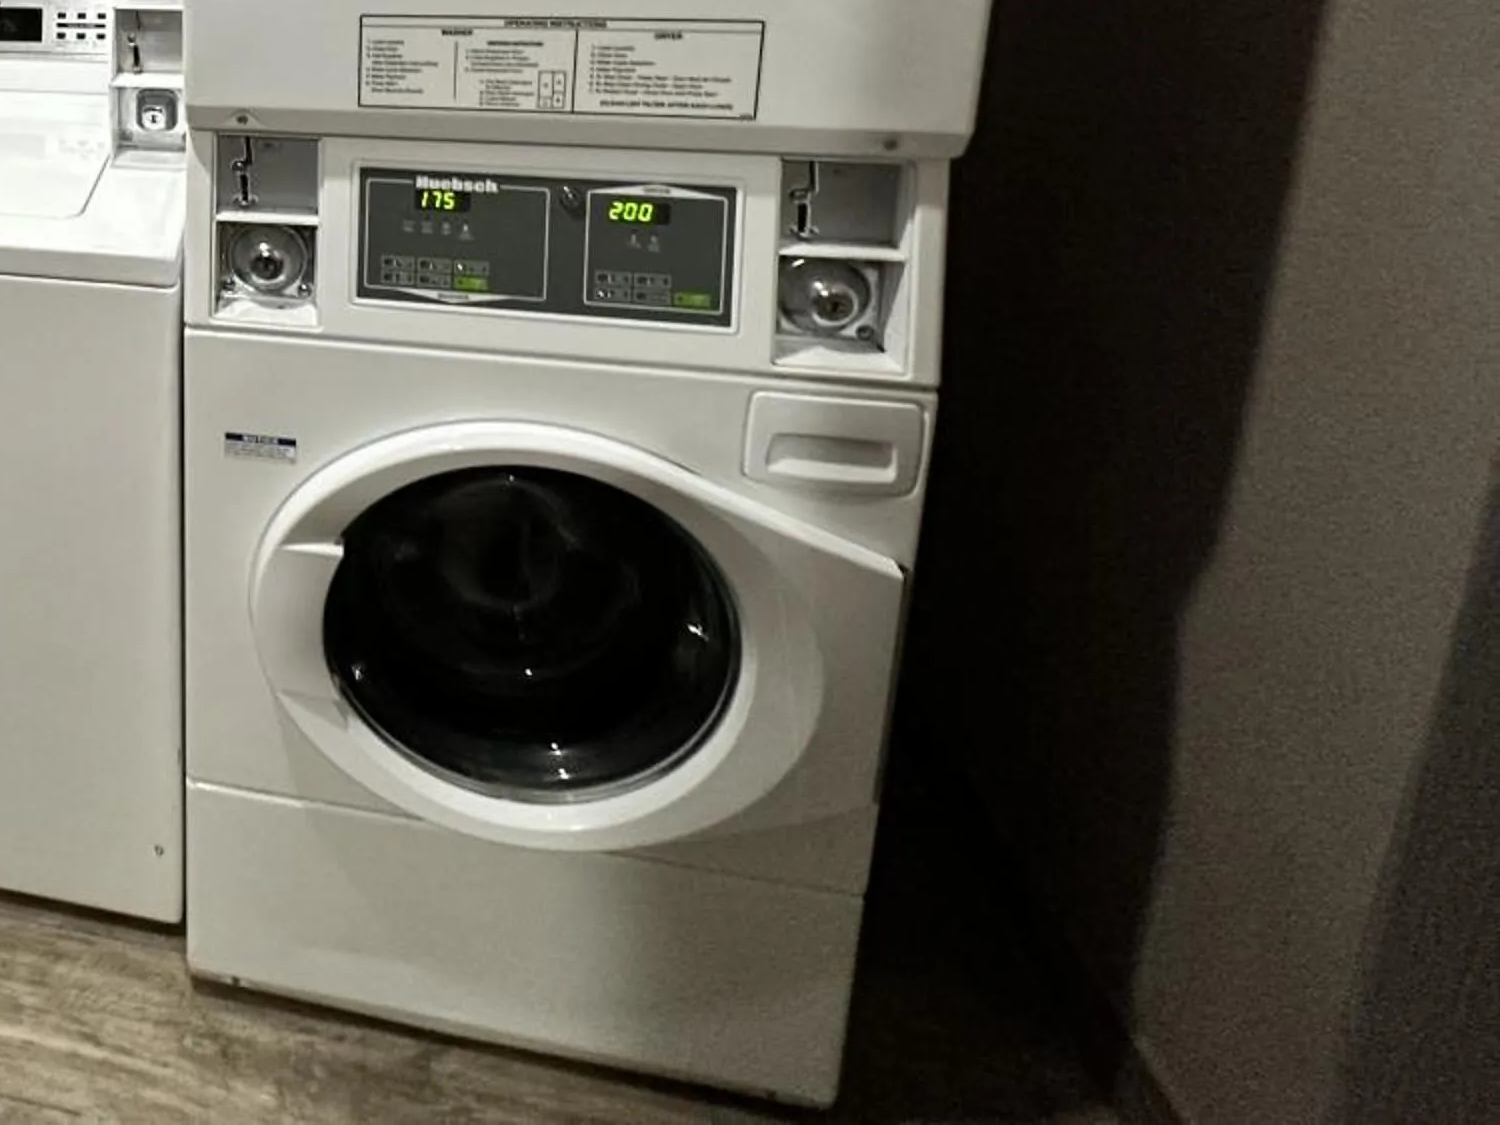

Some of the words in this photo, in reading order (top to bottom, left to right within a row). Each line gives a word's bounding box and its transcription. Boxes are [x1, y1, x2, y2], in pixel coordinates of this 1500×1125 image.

[415, 176, 498, 193] Huebsch
[421, 191, 456, 210] 175
[609, 202, 653, 222] 200
